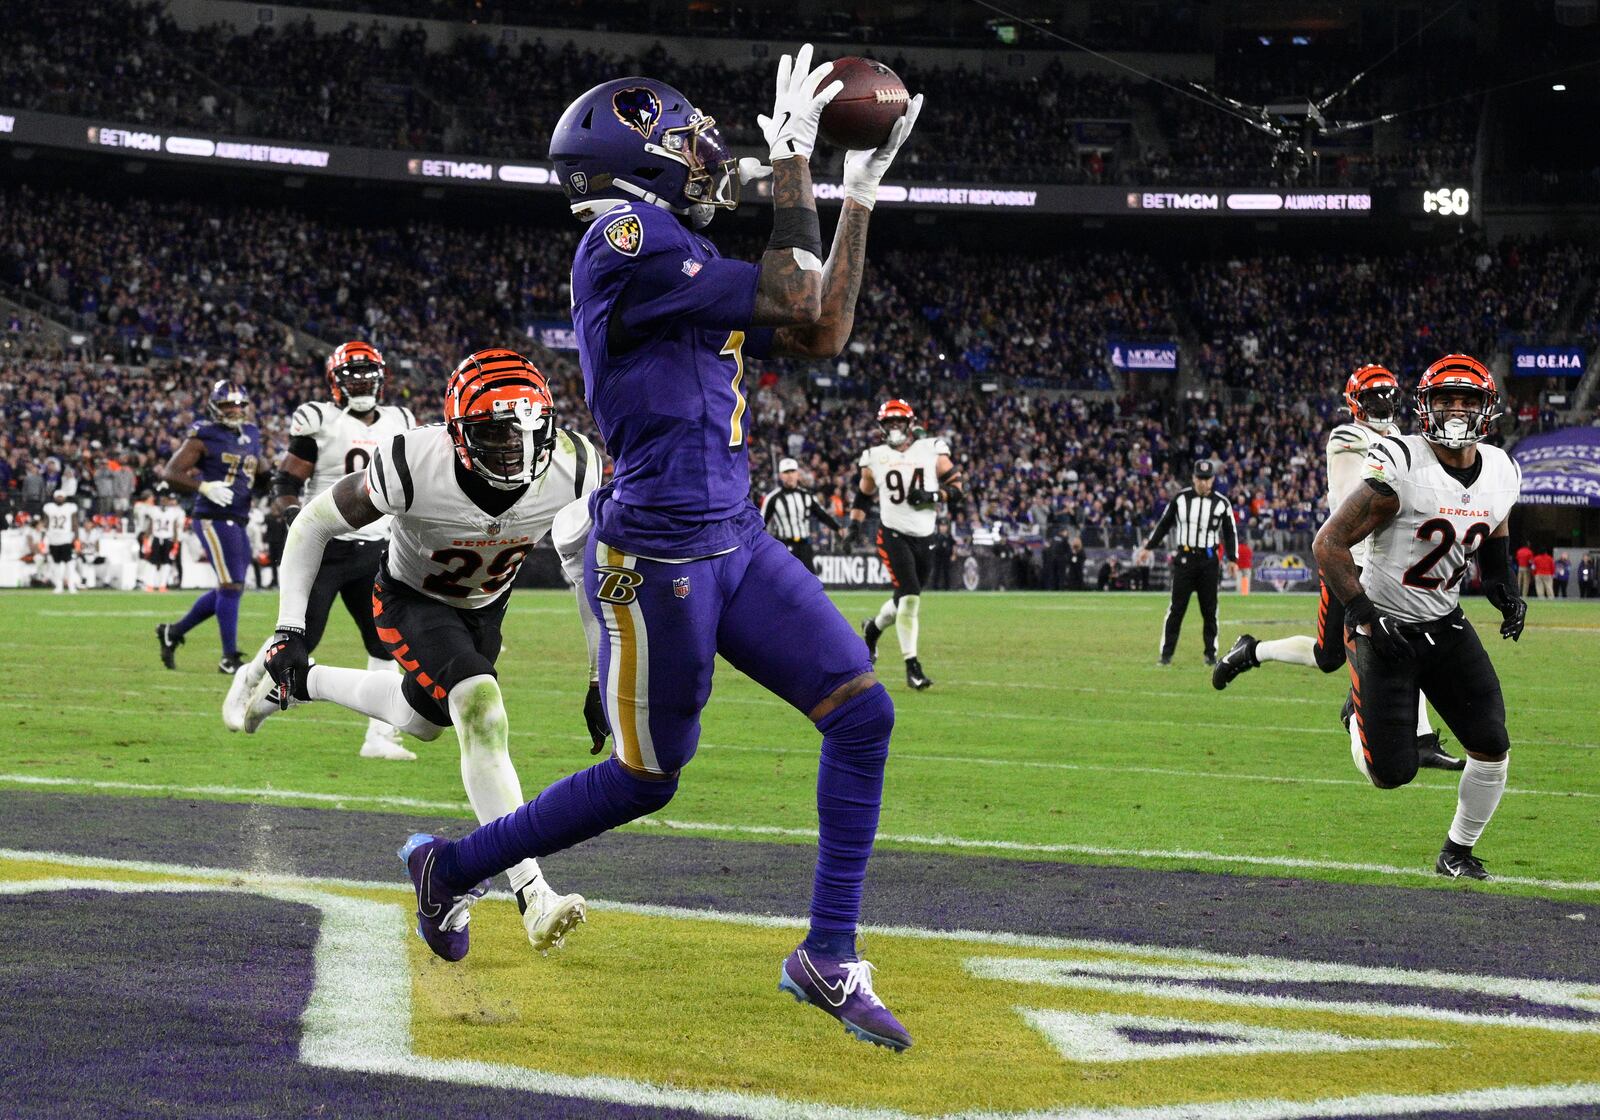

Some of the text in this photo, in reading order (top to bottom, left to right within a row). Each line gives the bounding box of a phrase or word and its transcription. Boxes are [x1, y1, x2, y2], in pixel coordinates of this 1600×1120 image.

[100, 127, 161, 151] BETMGM
[422, 159, 492, 180] BETMGM
[1142, 193, 1218, 209] BETMGM
[1284, 194, 1326, 210] ALWAYS
[1327, 194, 1347, 210] BET
[1127, 349, 1176, 361] MORGAN
[221, 452, 258, 489] 79
[885, 467, 925, 505] 94
[1553, 496, 1589, 505] HEALTH
[1439, 507, 1489, 517] BENGALS
[450, 536, 529, 547] BENGALS
[422, 543, 536, 598] 29
[593, 566, 644, 604] B
